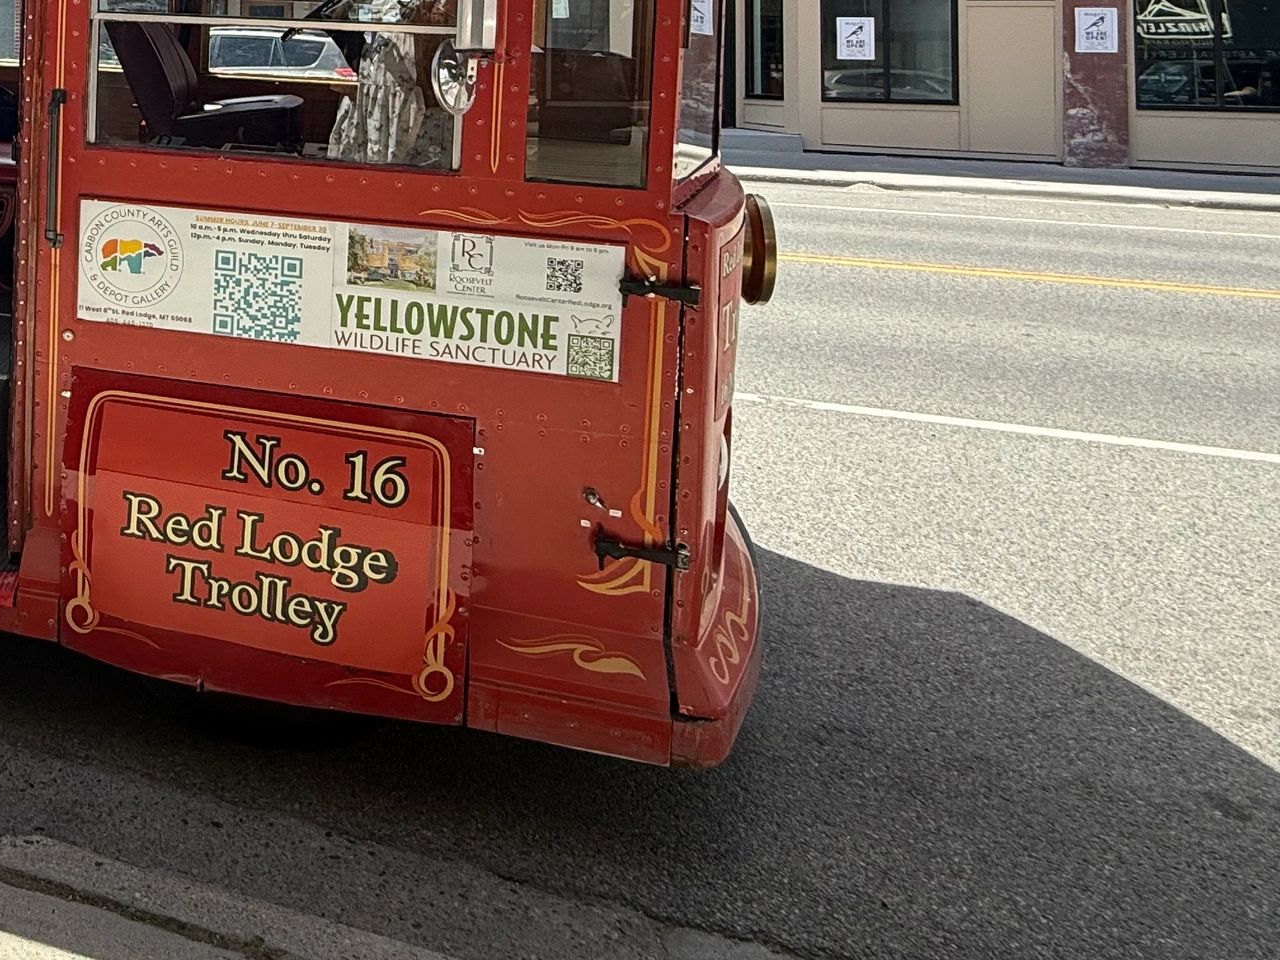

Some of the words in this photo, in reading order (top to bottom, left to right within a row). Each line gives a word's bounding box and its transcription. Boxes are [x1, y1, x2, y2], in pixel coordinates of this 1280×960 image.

[84, 220, 105, 263] CARBON
[103, 208, 149, 224] COUNTY
[148, 215, 172, 239] ARTS
[167, 239, 179, 272] GUILD
[240, 228, 280, 238] Wednesday
[282, 231, 298, 240] thru
[298, 233, 332, 244] Saturday
[300, 242, 331, 253] Tuesday
[85, 305, 102, 313] West
[121, 308, 135, 317] Red
[90, 273, 98, 282] &
[96, 281, 130, 304] DEPOT
[132, 280, 172, 305] GALLERY
[336, 294, 560, 351] YELLOWSTONE
[334, 330, 423, 355] WILDLIFE
[429, 341, 557, 371] SANCTUARY
[224, 432, 322, 492] No.
[346, 452, 407, 506] 16
[123, 493, 224, 550] Red
[236, 513, 390, 589] Lodge
[167, 556, 344, 644] Trolley
